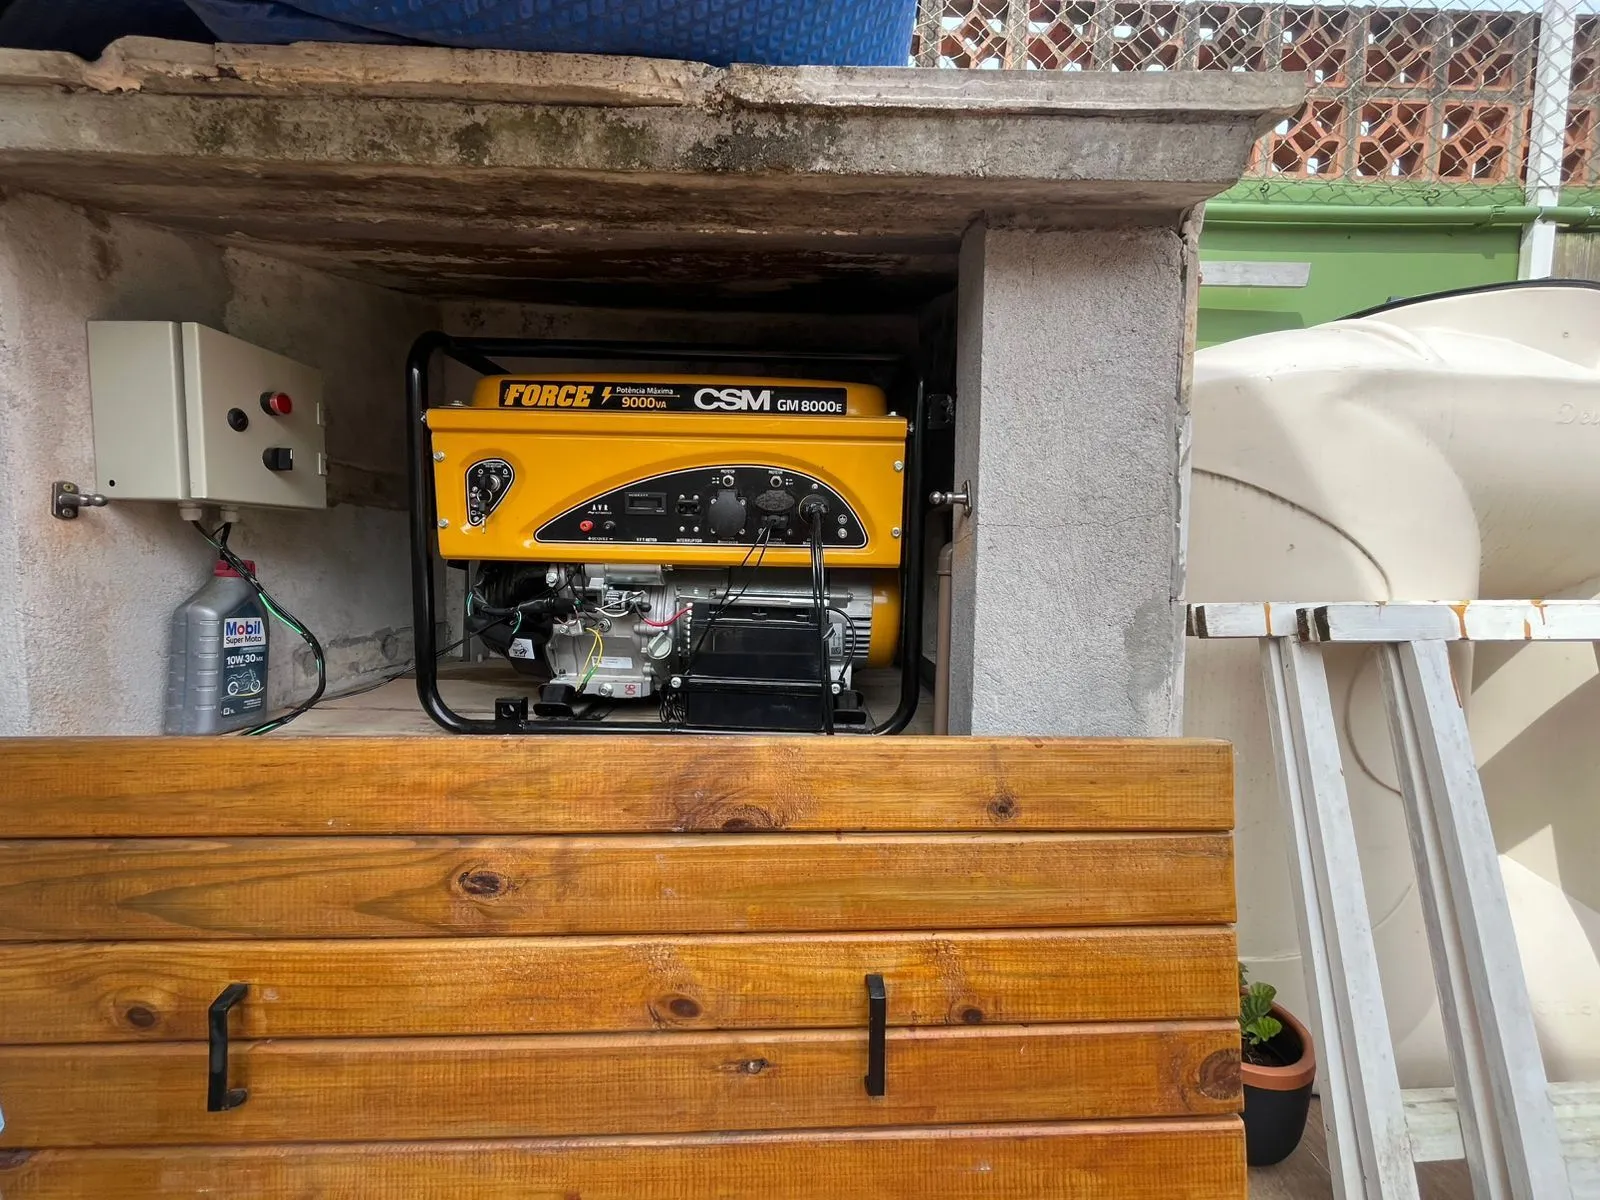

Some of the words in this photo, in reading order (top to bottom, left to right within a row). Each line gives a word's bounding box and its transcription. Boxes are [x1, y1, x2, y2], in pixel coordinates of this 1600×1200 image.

[504, 384, 594, 407] FORCE
[616, 386, 645, 395] Potência
[646, 387, 674, 395] Máxima
[694, 388, 771, 411] CSM
[777, 400, 799, 412] GM
[801, 400, 842, 413] 8000E
[226, 621, 261, 636] Mobil
[225, 637, 244, 646] Super
